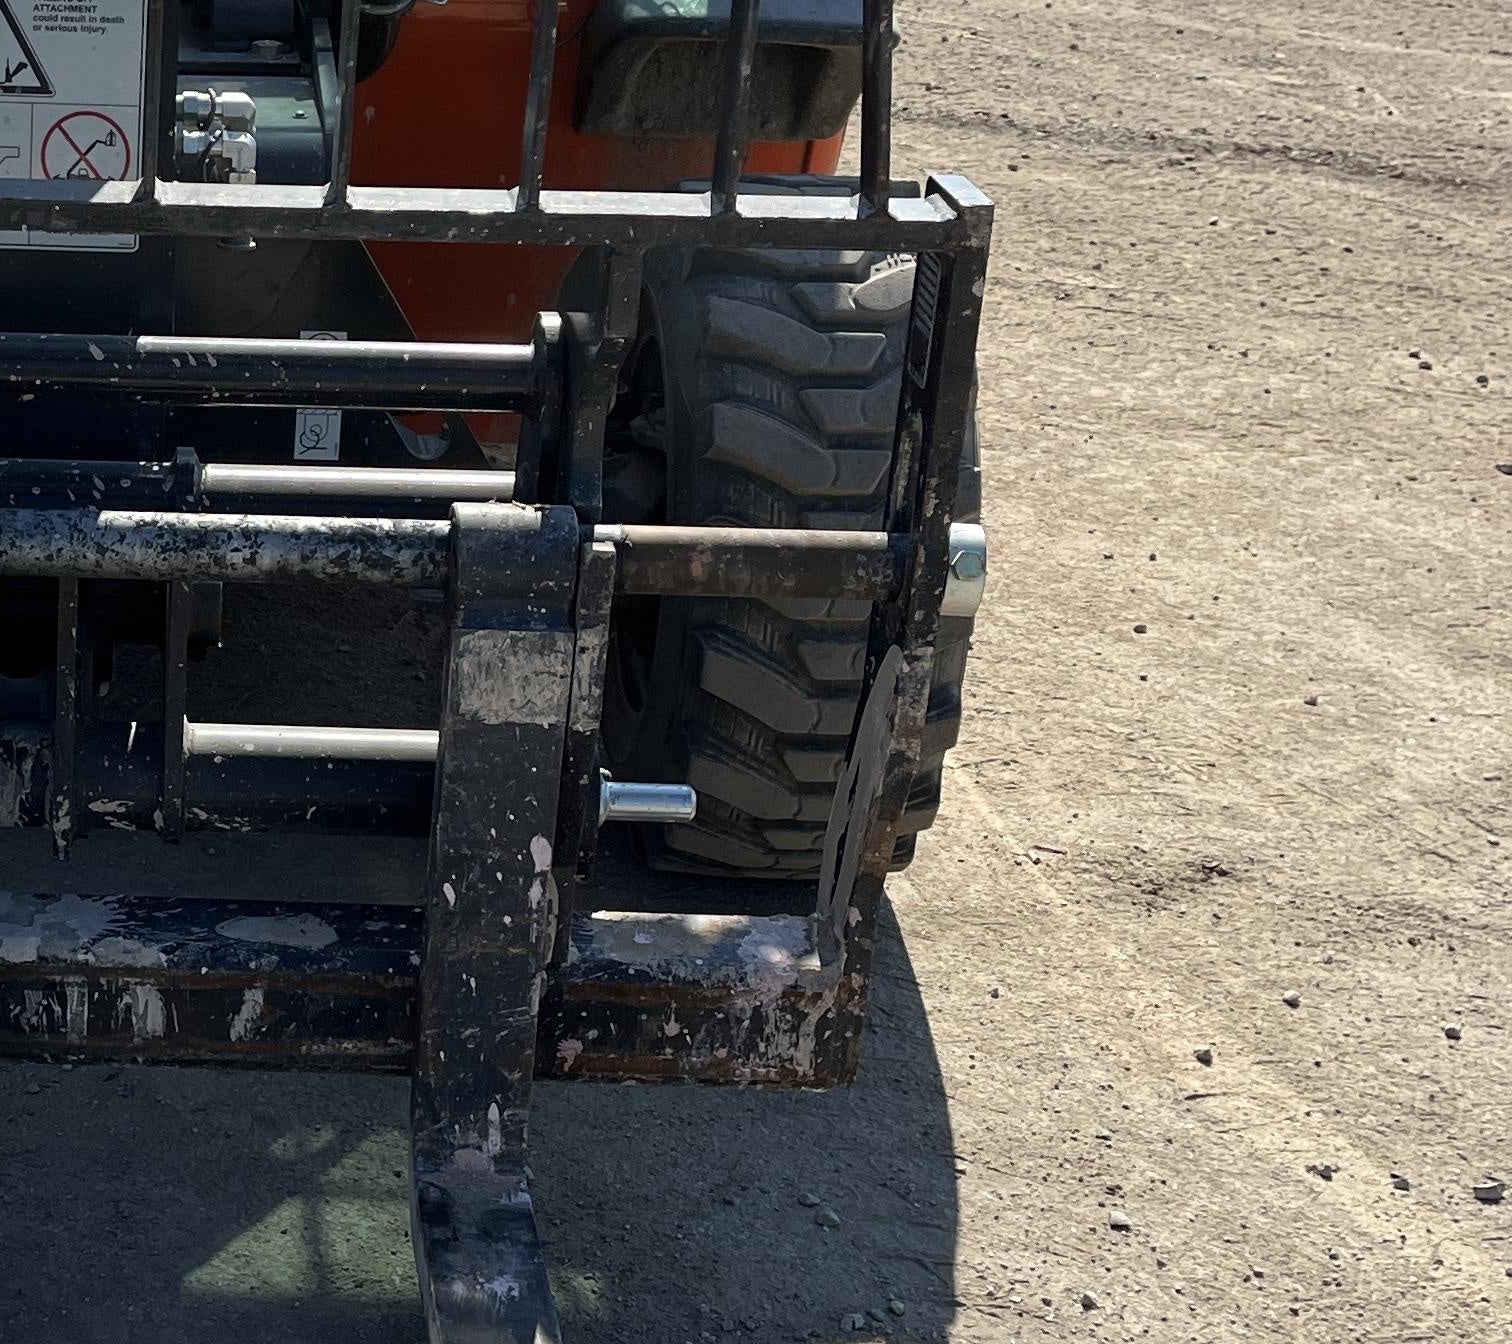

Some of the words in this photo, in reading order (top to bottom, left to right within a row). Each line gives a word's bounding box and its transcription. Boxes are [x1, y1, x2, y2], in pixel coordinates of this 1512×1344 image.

[33, 3, 98, 14] ATTACHMENT
[33, 14, 58, 23] could
[61, 14, 87, 23] result
[89, 15, 98, 23] in
[100, 15, 125, 24] death
[45, 24, 78, 33] serious
